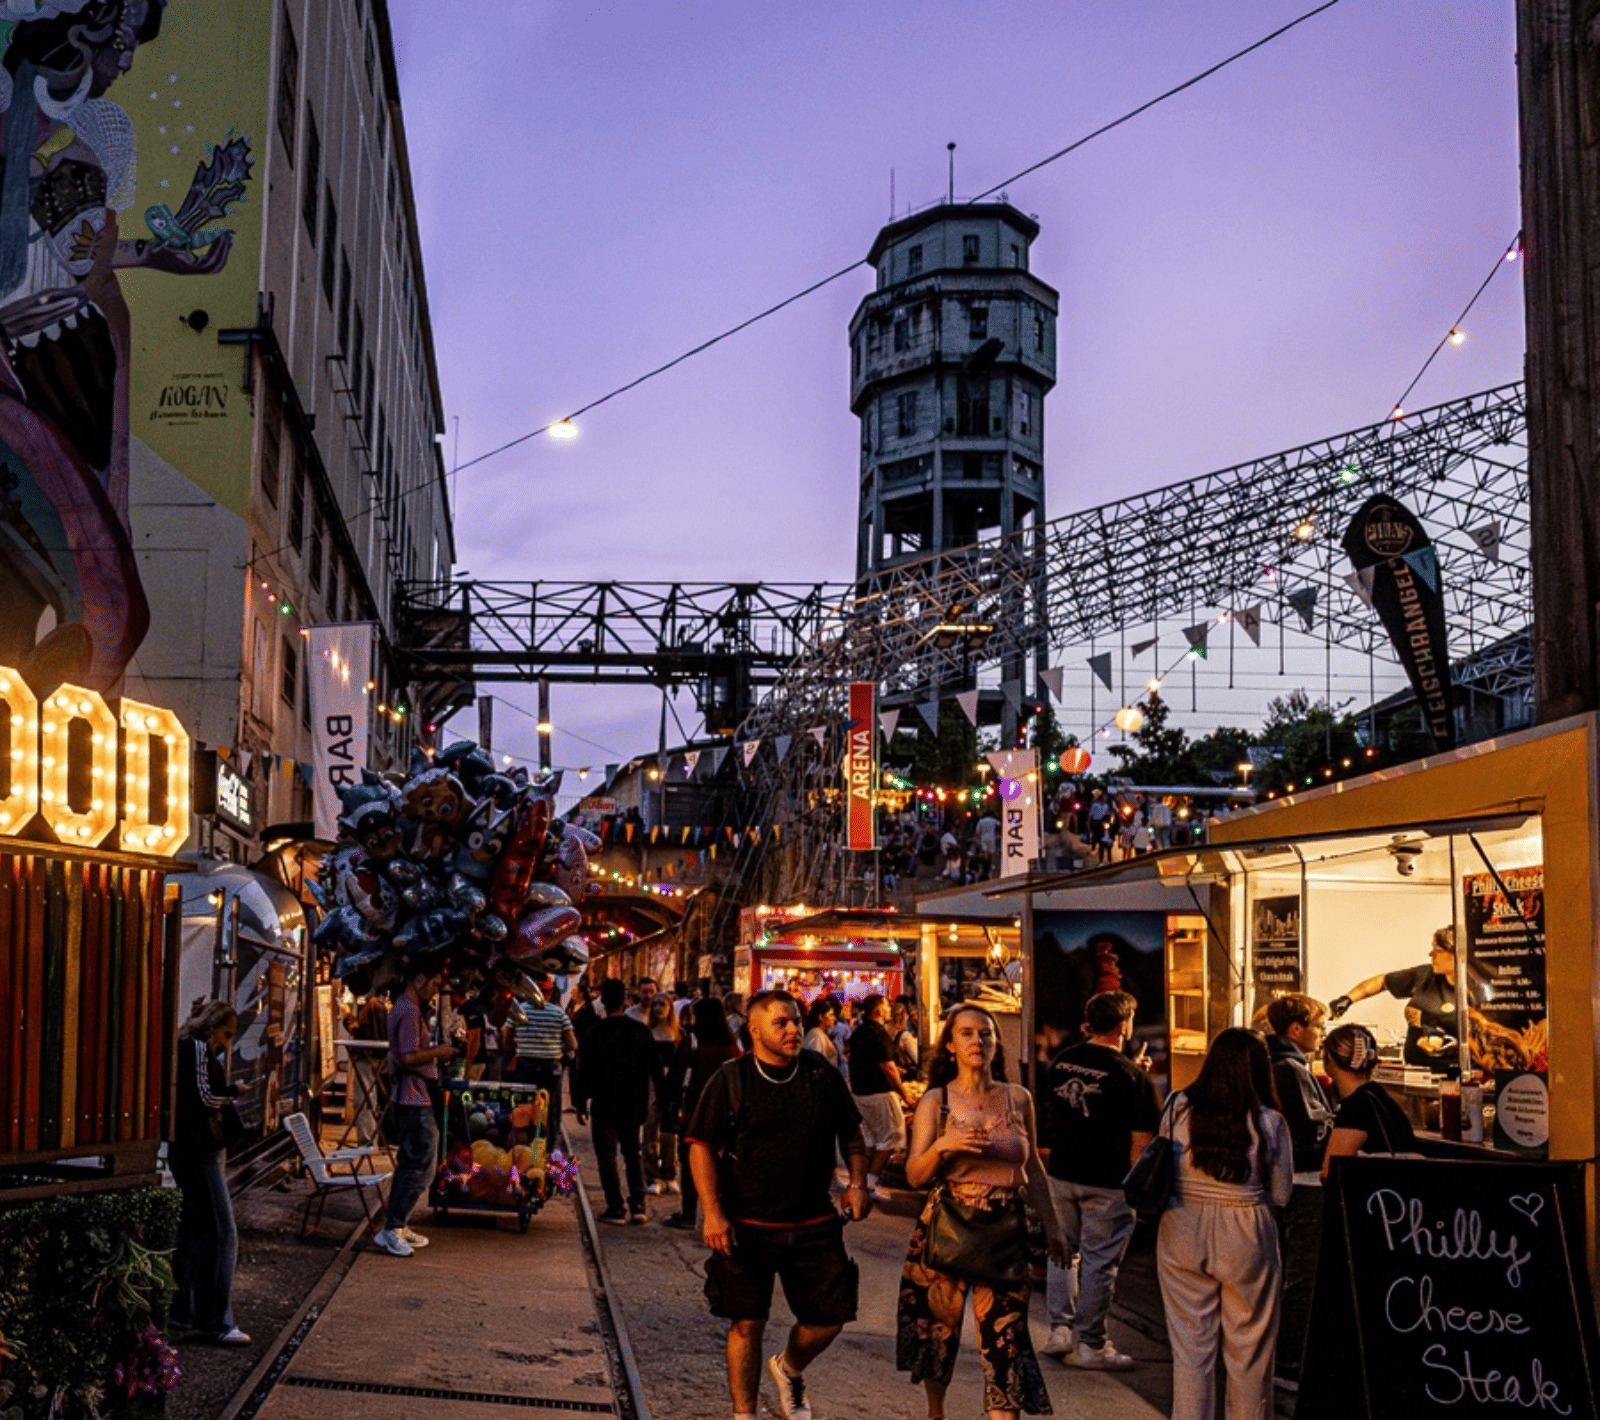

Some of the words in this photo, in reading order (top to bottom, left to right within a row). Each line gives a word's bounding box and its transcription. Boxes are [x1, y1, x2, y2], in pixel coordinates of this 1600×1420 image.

[852, 730, 871, 800] ARENA
[1366, 1188, 1532, 1288] Philly
[1385, 1275, 1531, 1334] Cheese
[1422, 1343, 1572, 1416] Steak
